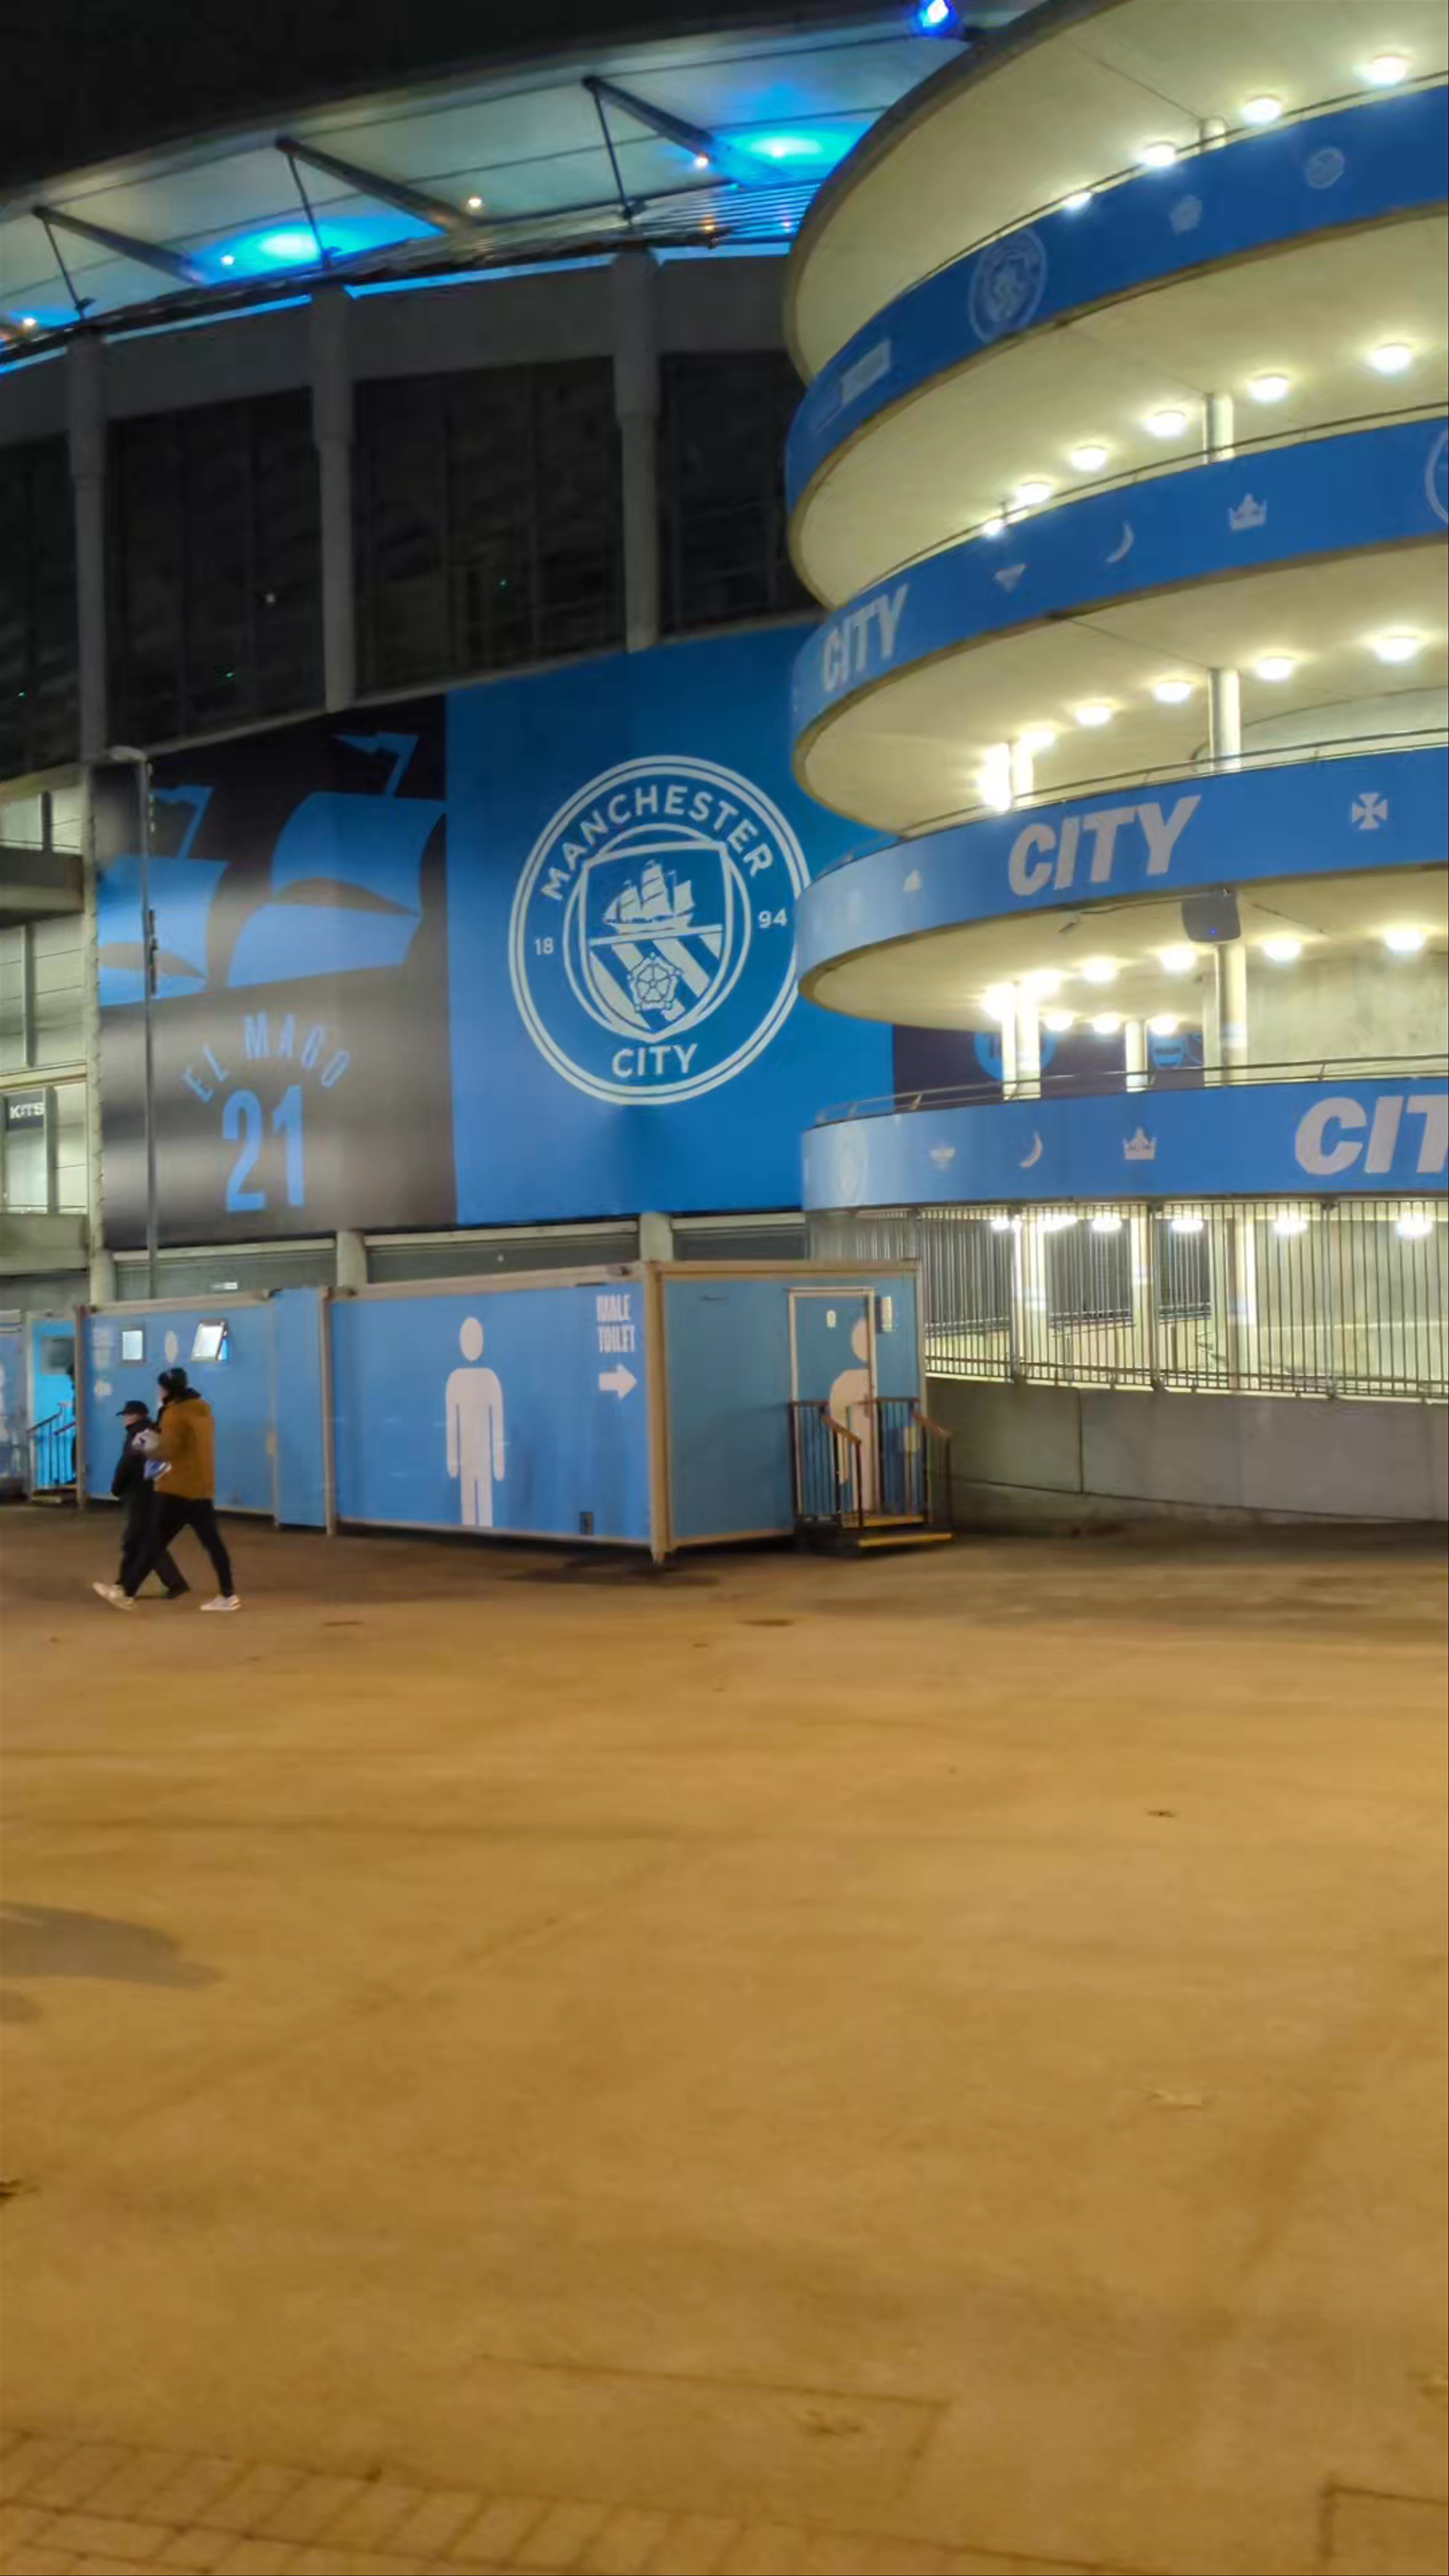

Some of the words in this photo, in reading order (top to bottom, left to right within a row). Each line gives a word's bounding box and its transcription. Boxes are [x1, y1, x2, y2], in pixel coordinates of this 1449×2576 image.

[822, 583, 909, 692] CITY
[540, 784, 773, 901] MANCHESTER
[1008, 795, 1201, 897] CITY
[758, 908, 787, 929] 94
[534, 937, 555, 955] 18
[612, 1043, 698, 1078] CITY
[10, 1101, 45, 1119] KITS
[222, 1084, 305, 1213] 21
[596, 1295, 631, 1322] MALE
[598, 1324, 635, 1353] TOILET
